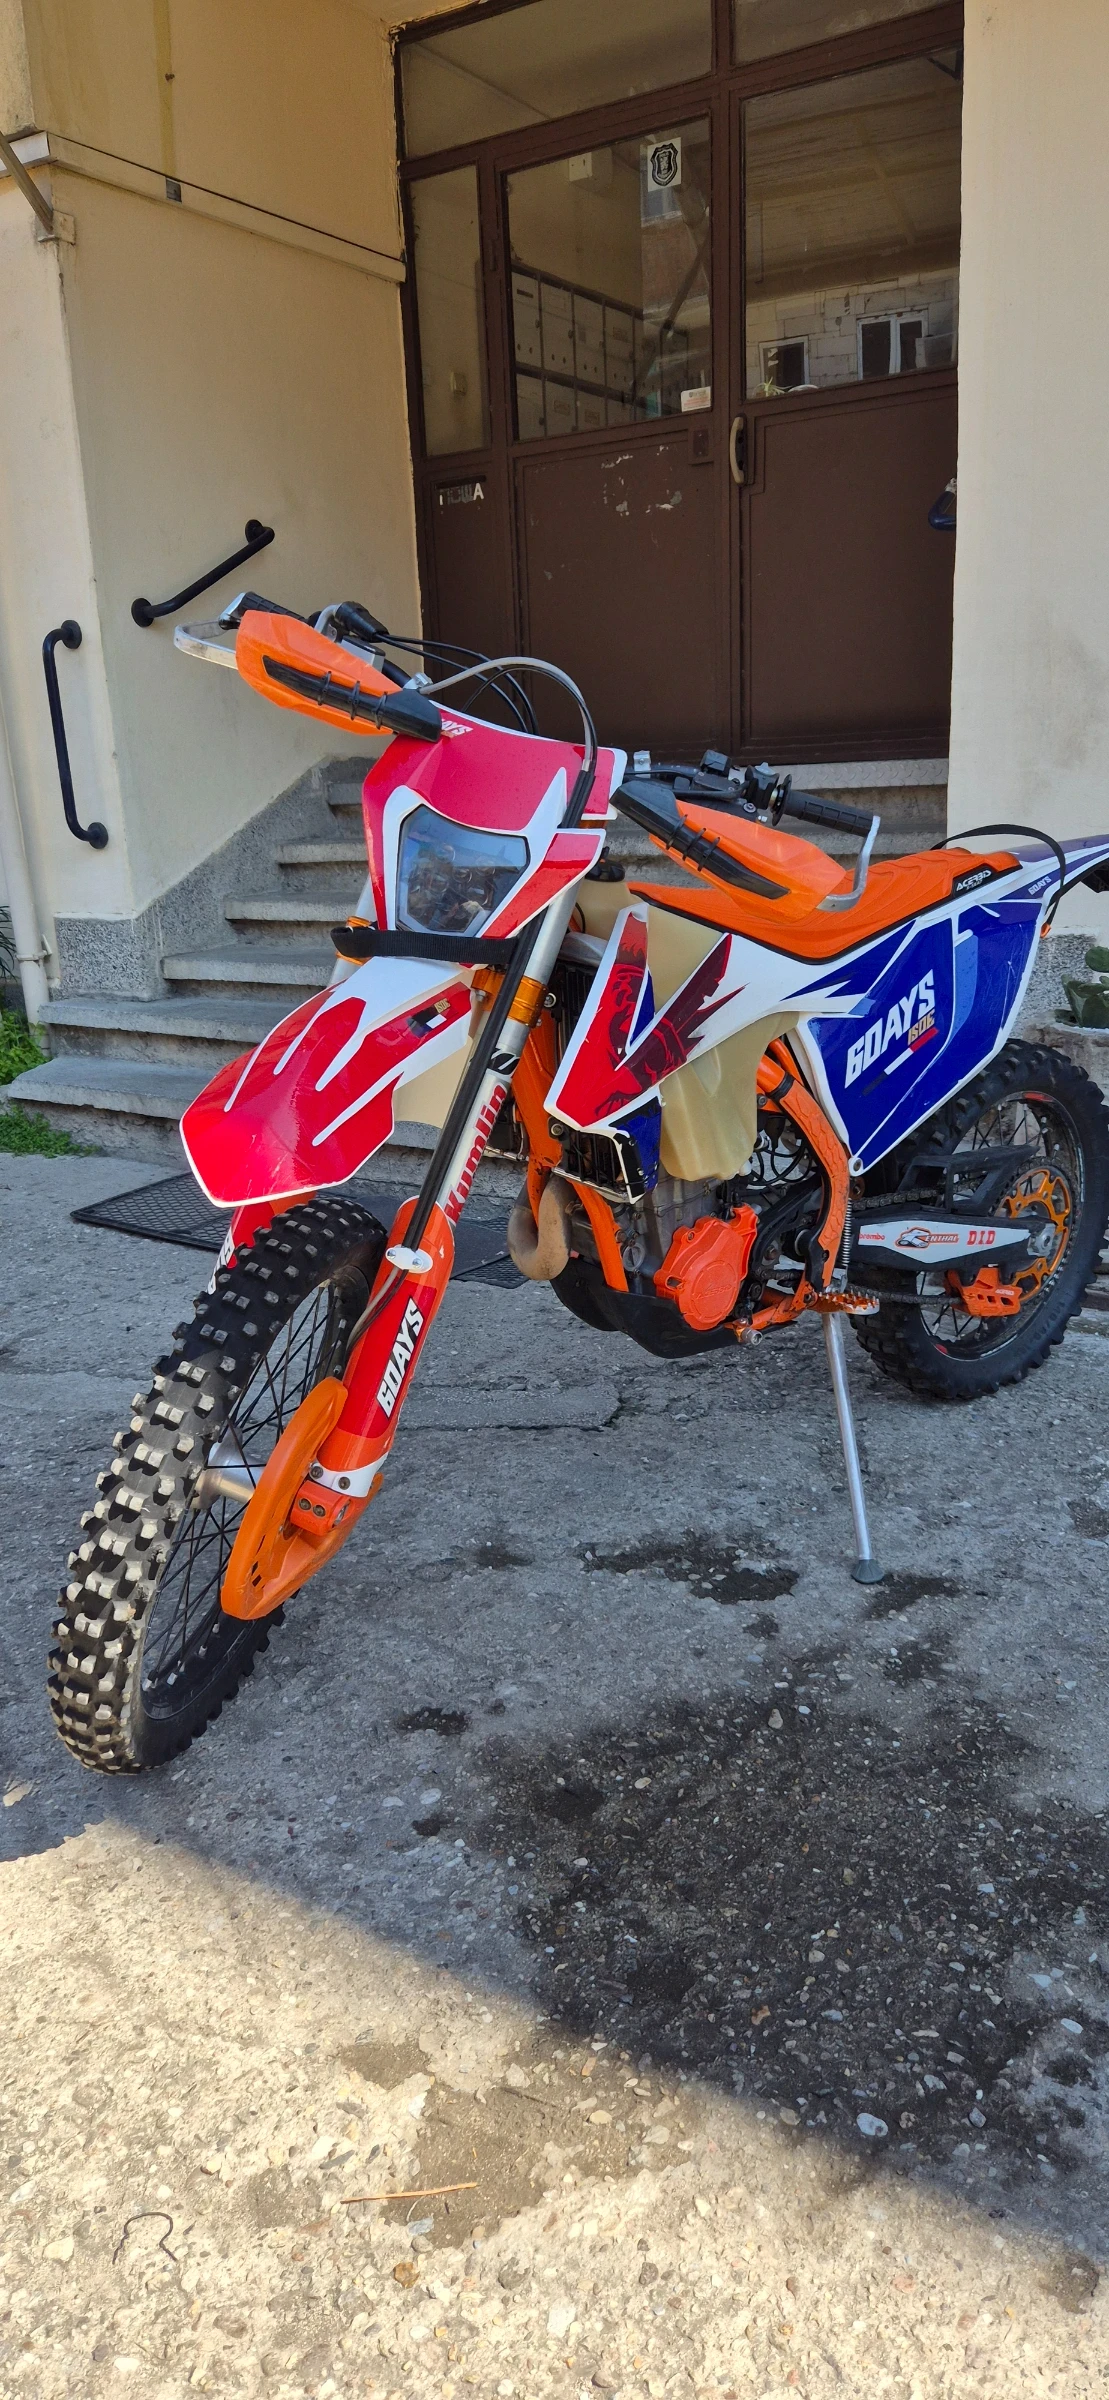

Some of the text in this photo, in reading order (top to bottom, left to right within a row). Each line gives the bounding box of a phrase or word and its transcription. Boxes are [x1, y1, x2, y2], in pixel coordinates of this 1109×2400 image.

[956, 870, 992, 892] ACERBIS
[1027, 876, 1052, 896] 6DAYS
[844, 969, 936, 1090] 6DAYS
[907, 1008, 936, 1046] ISDE
[443, 1083, 508, 1225] Kumlin
[376, 1298, 424, 1419] 6DAYS
